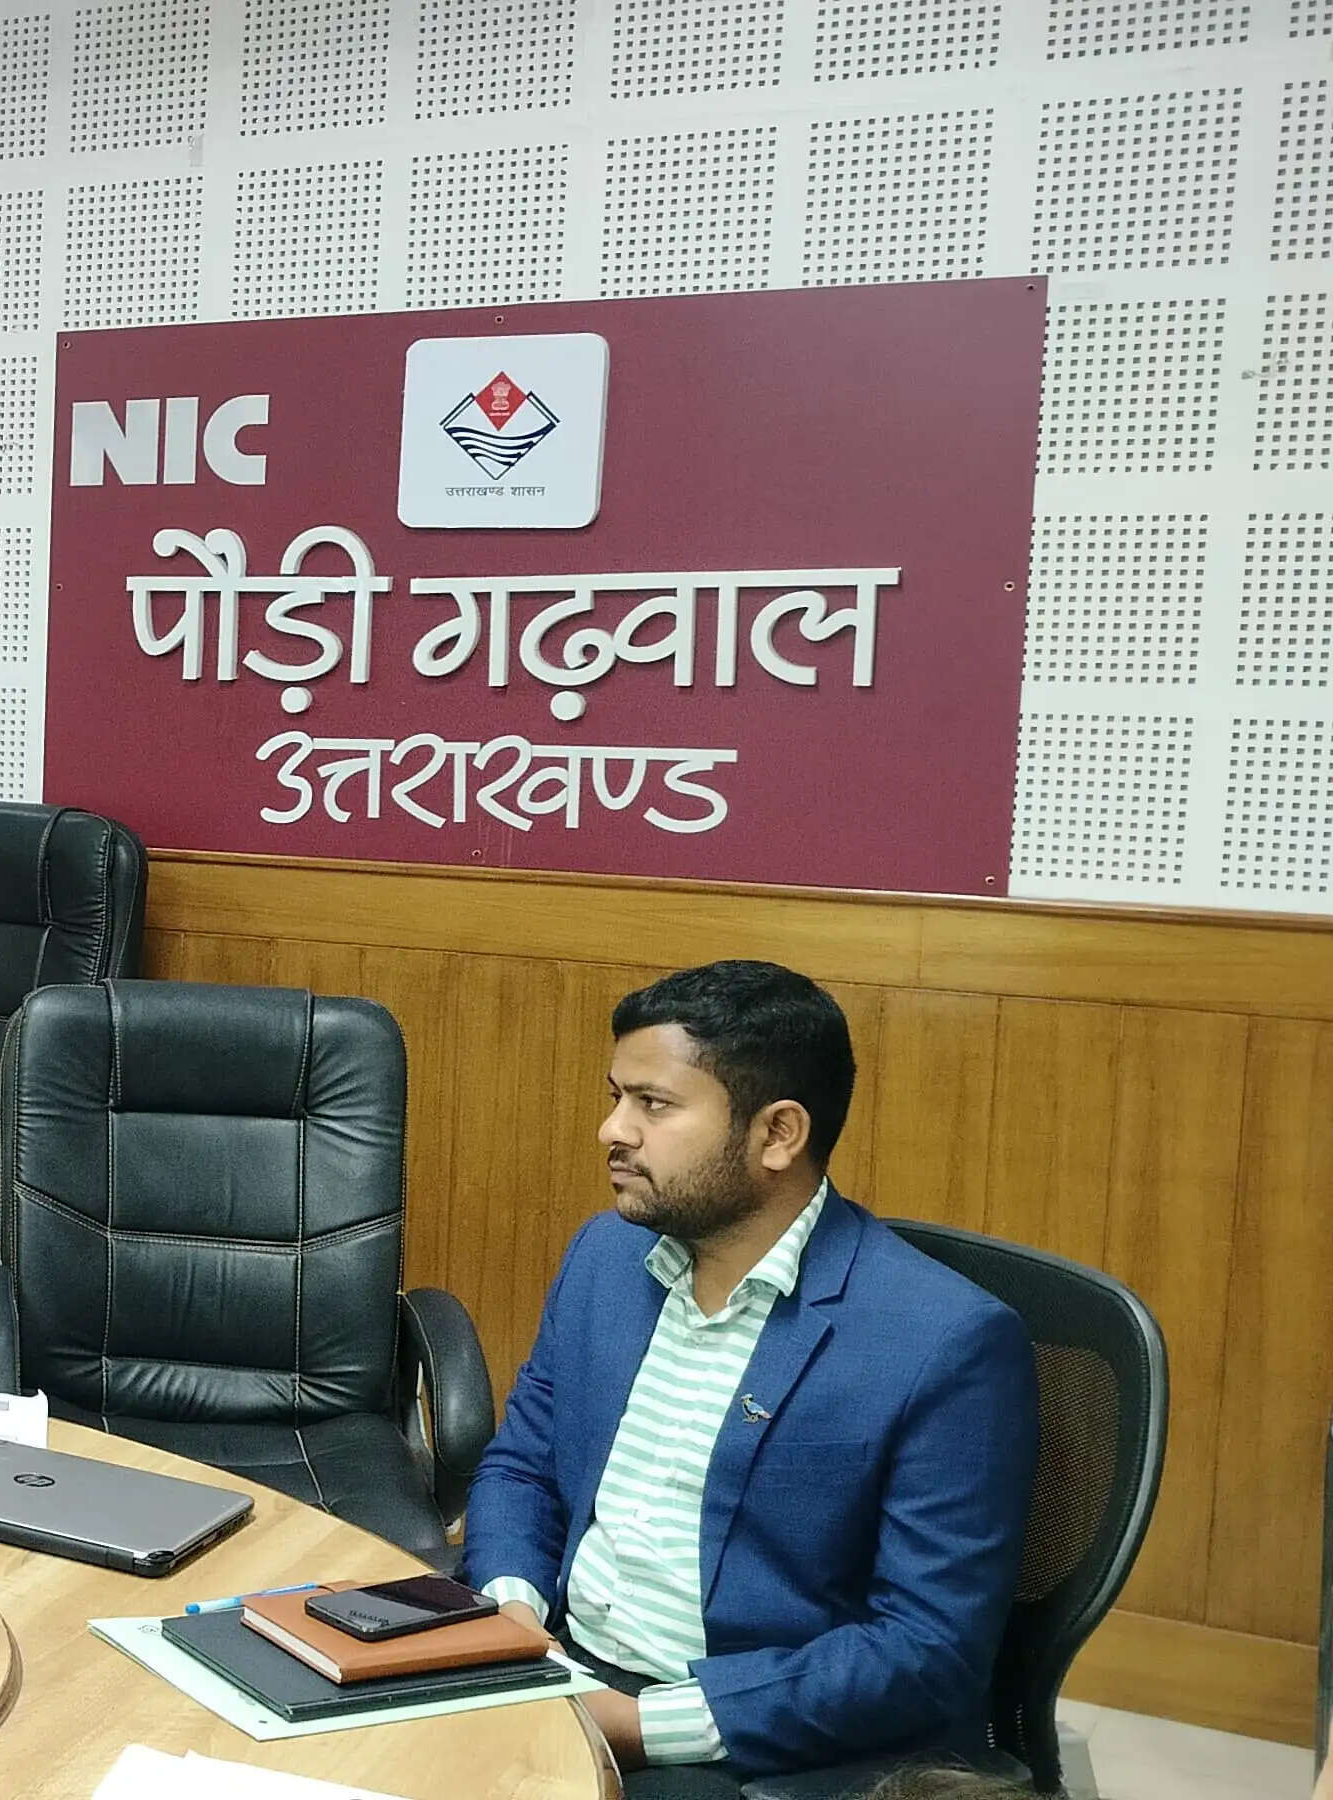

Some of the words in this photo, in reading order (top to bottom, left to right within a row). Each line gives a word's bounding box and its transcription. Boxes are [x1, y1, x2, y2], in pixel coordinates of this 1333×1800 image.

[69, 394, 271, 487] NIC
[445, 486, 504, 496] उत्तराखण्ड
[510, 486, 545, 496] शासन
[125, 525, 393, 715] पौड़ी
[411, 566, 901, 722] गढ़वाल
[256, 730, 738, 834] उत्तराखण्ड
